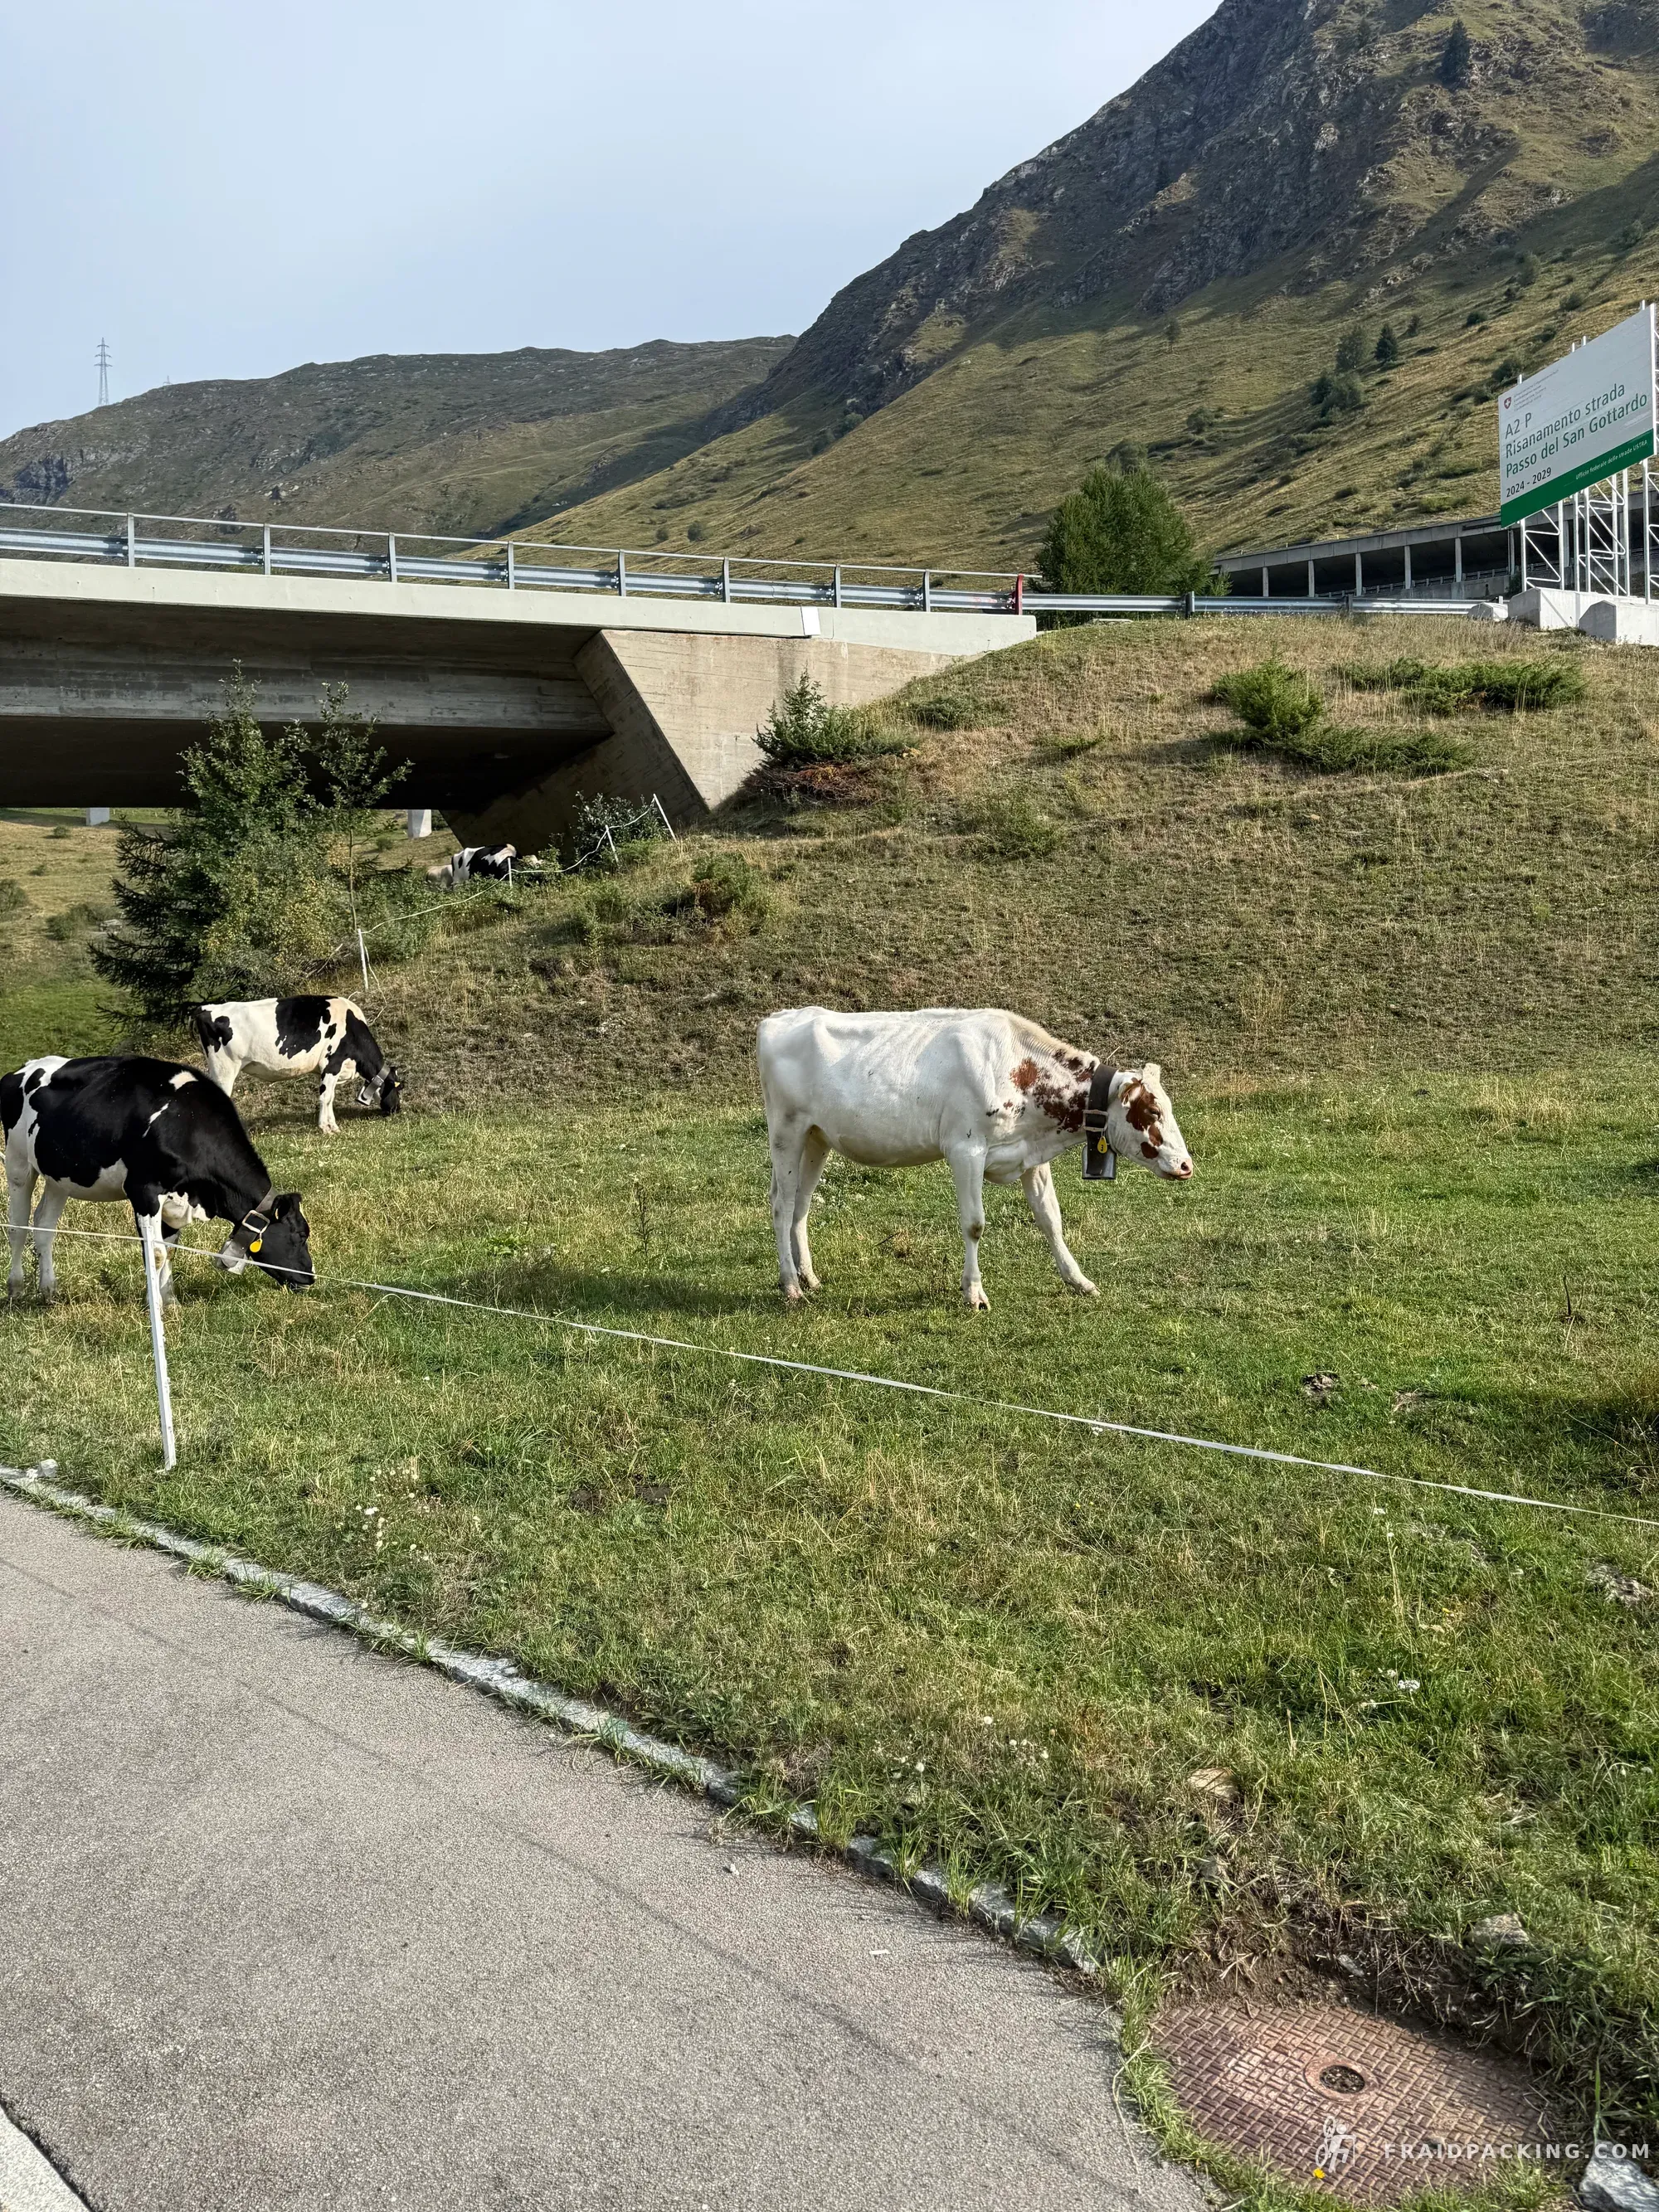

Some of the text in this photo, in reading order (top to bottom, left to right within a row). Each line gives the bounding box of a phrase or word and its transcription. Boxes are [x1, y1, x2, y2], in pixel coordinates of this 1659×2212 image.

[1505, 412, 1532, 440] A2 P
[1506, 408, 1581, 459] Risanamento
[1585, 383, 1625, 416] strada
[1506, 393, 1647, 479] Passo del San Gottardo
[1575, 469, 1589, 480] Ufficio
[1589, 460, 1607, 473] federale
[1607, 455, 1618, 464] delle
[1632, 440, 1648, 451] USTRA
[1506, 480, 1525, 498] 2024
[1532, 467, 1551, 484] 2029
